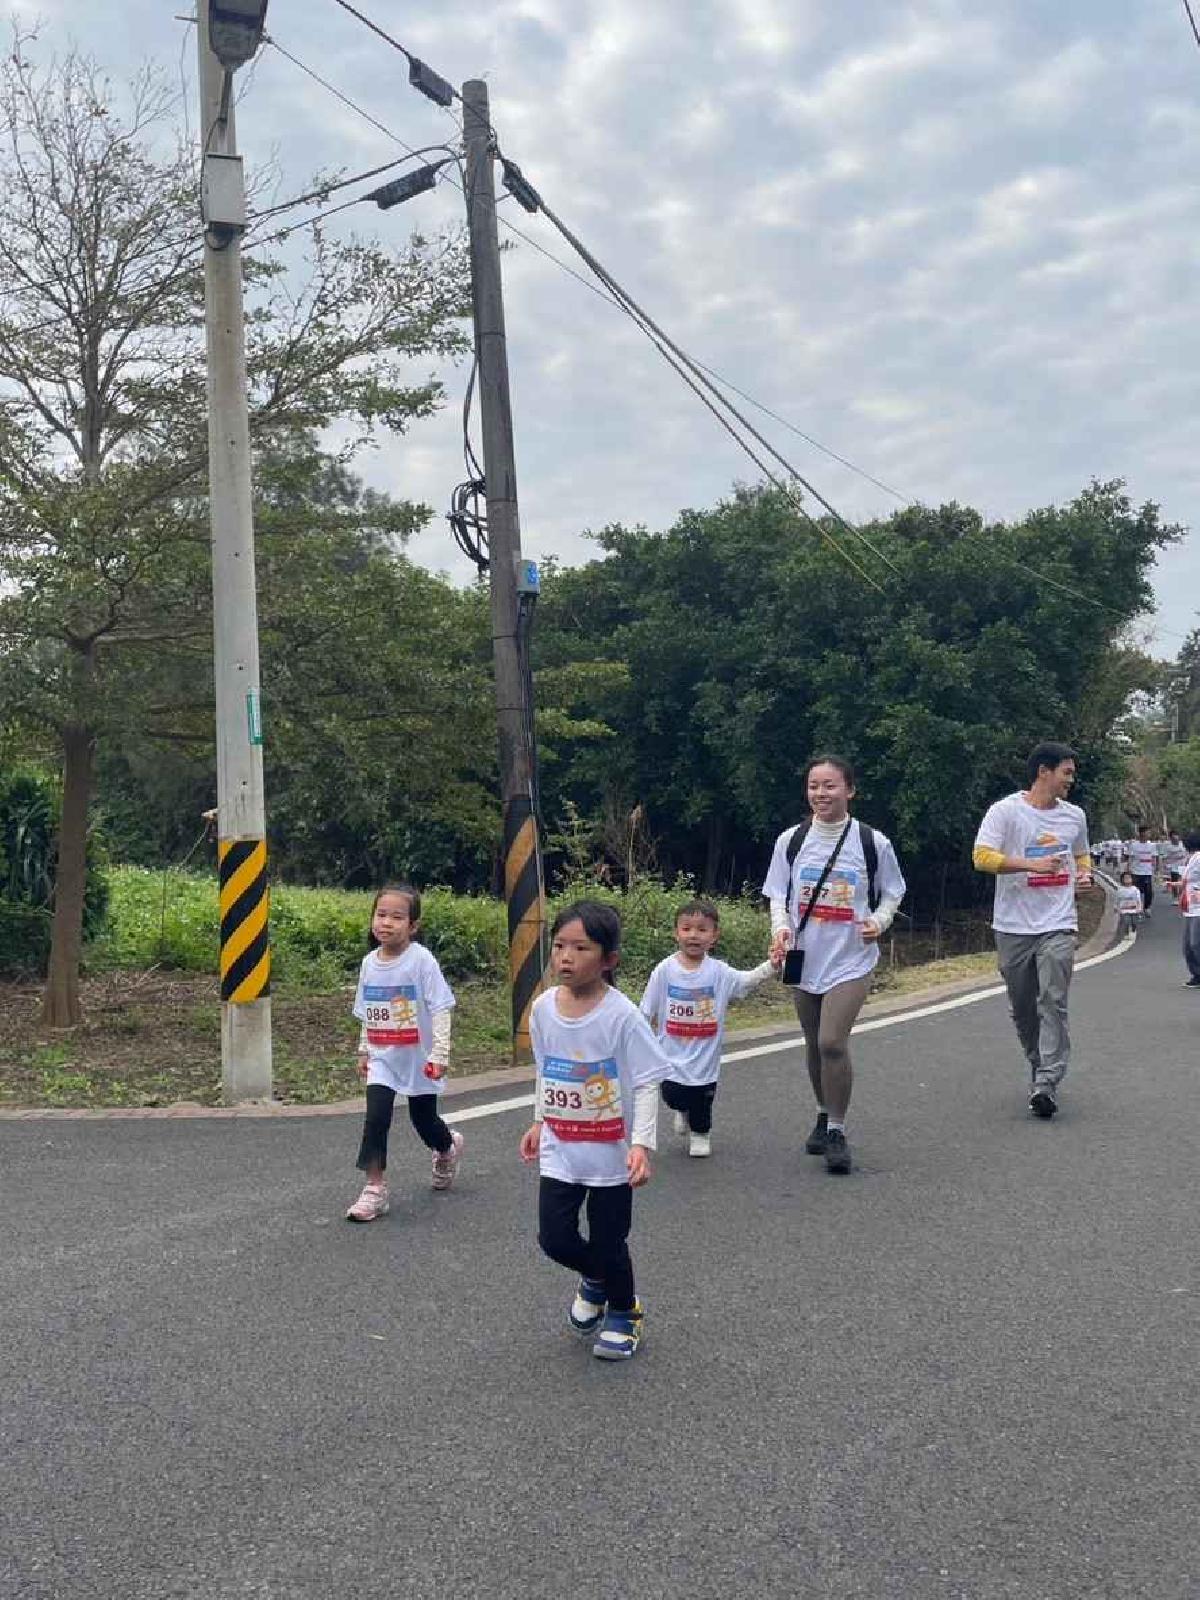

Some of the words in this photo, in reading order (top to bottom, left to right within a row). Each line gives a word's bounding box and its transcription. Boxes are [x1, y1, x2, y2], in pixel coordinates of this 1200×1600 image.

[802, 886, 829, 899] 27
[670, 1004, 694, 1017] 206
[544, 1088, 582, 1109] 393
